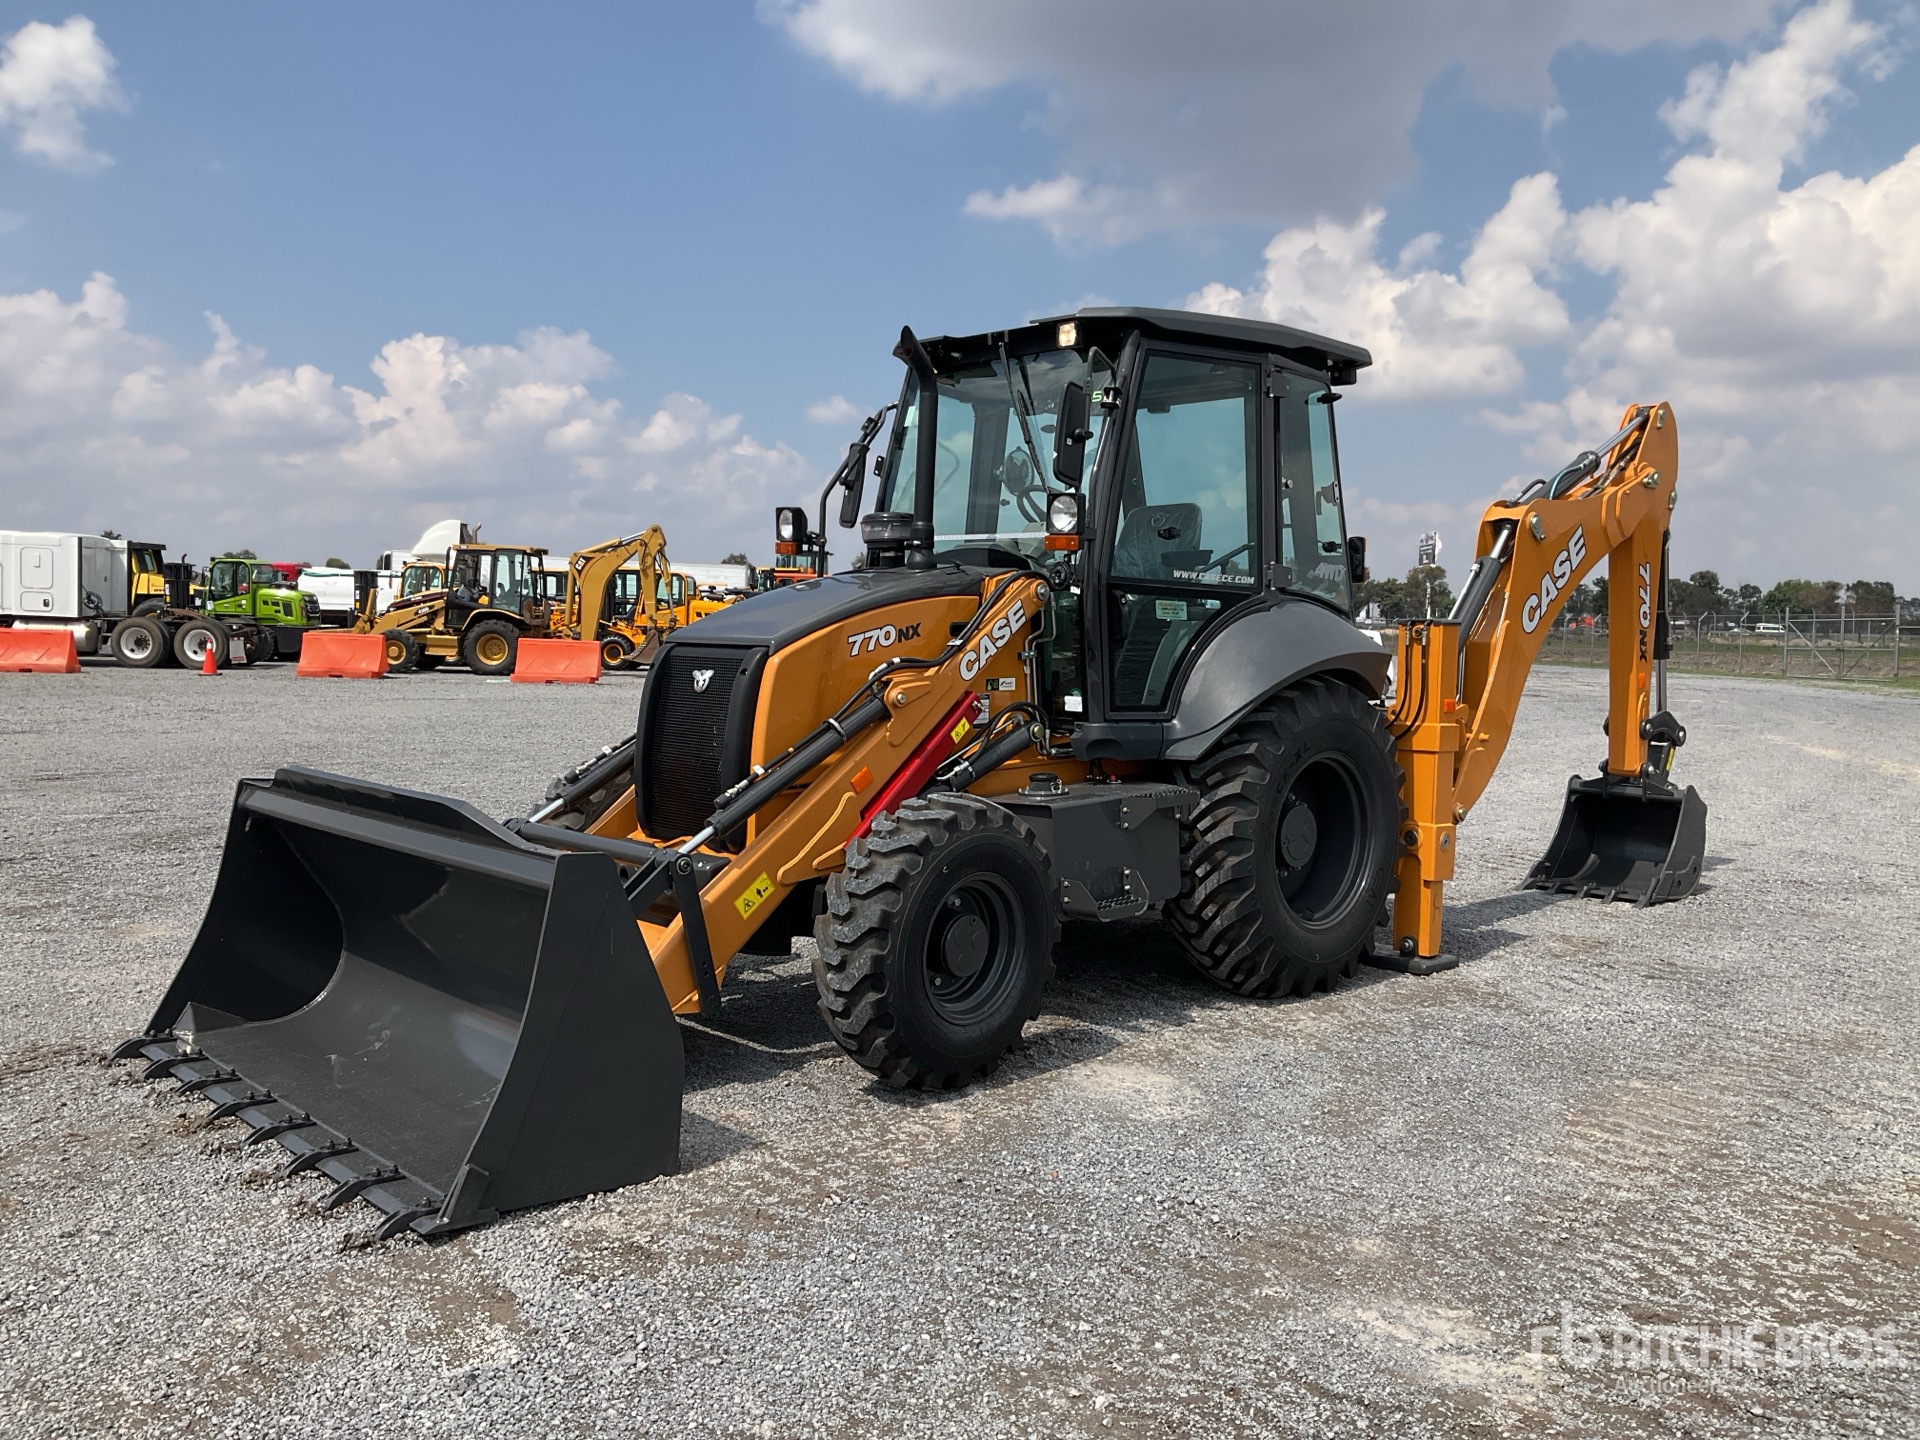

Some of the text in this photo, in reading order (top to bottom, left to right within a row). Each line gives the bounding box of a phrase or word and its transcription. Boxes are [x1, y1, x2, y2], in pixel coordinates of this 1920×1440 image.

[574, 556, 587, 571] CAT
[1173, 569, 1255, 585] WWW.CASECE.COM
[1522, 524, 1587, 634] CASE
[847, 623, 922, 657] 770NX
[959, 598, 1027, 681] CASE
[1638, 562, 1651, 664] 770NX
